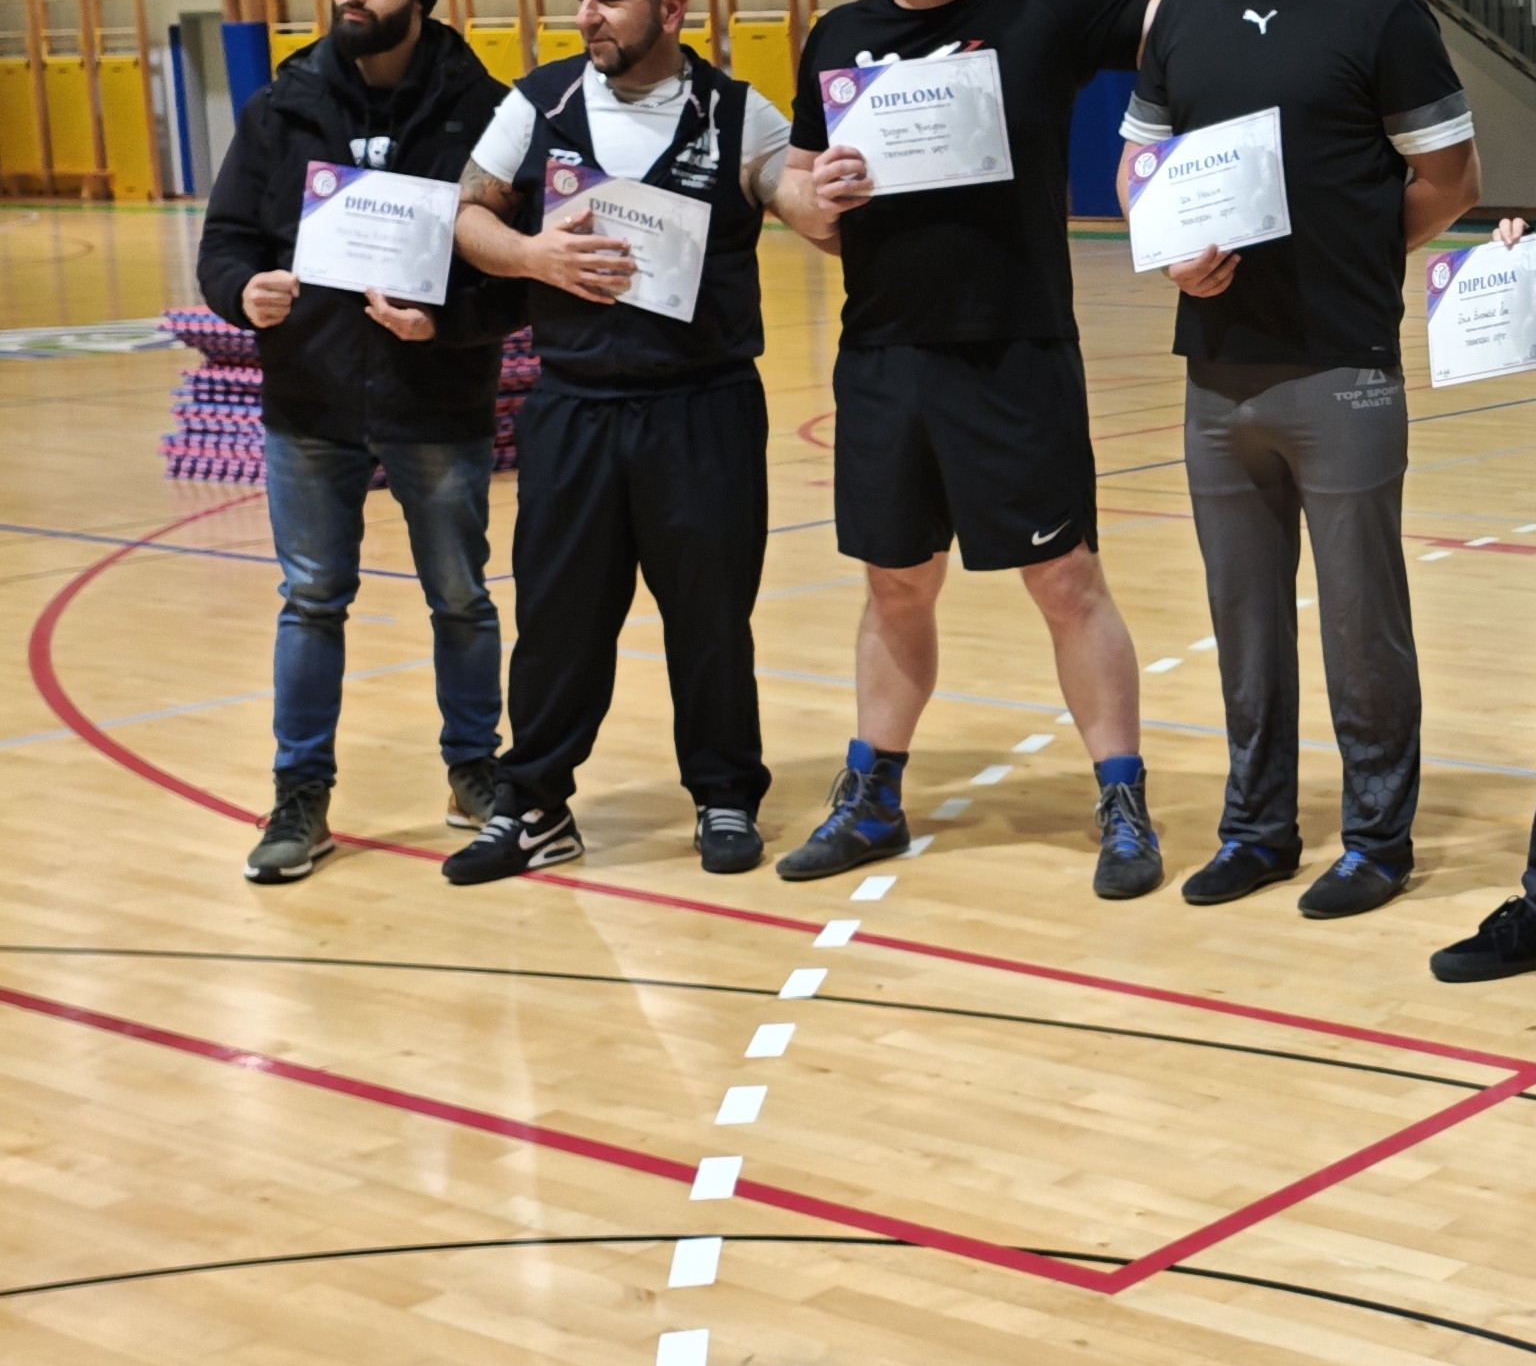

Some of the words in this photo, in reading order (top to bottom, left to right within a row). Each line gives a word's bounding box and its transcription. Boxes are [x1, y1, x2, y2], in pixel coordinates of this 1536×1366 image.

[869, 86, 954, 109] DIPLOMA
[1168, 149, 1241, 180] DIPLOMA
[344, 195, 415, 220] DIPLOMA
[588, 197, 665, 232] DIPLOMA
[1458, 269, 1518, 295] DIPLOMA
[1332, 390, 1363, 402] TOP
